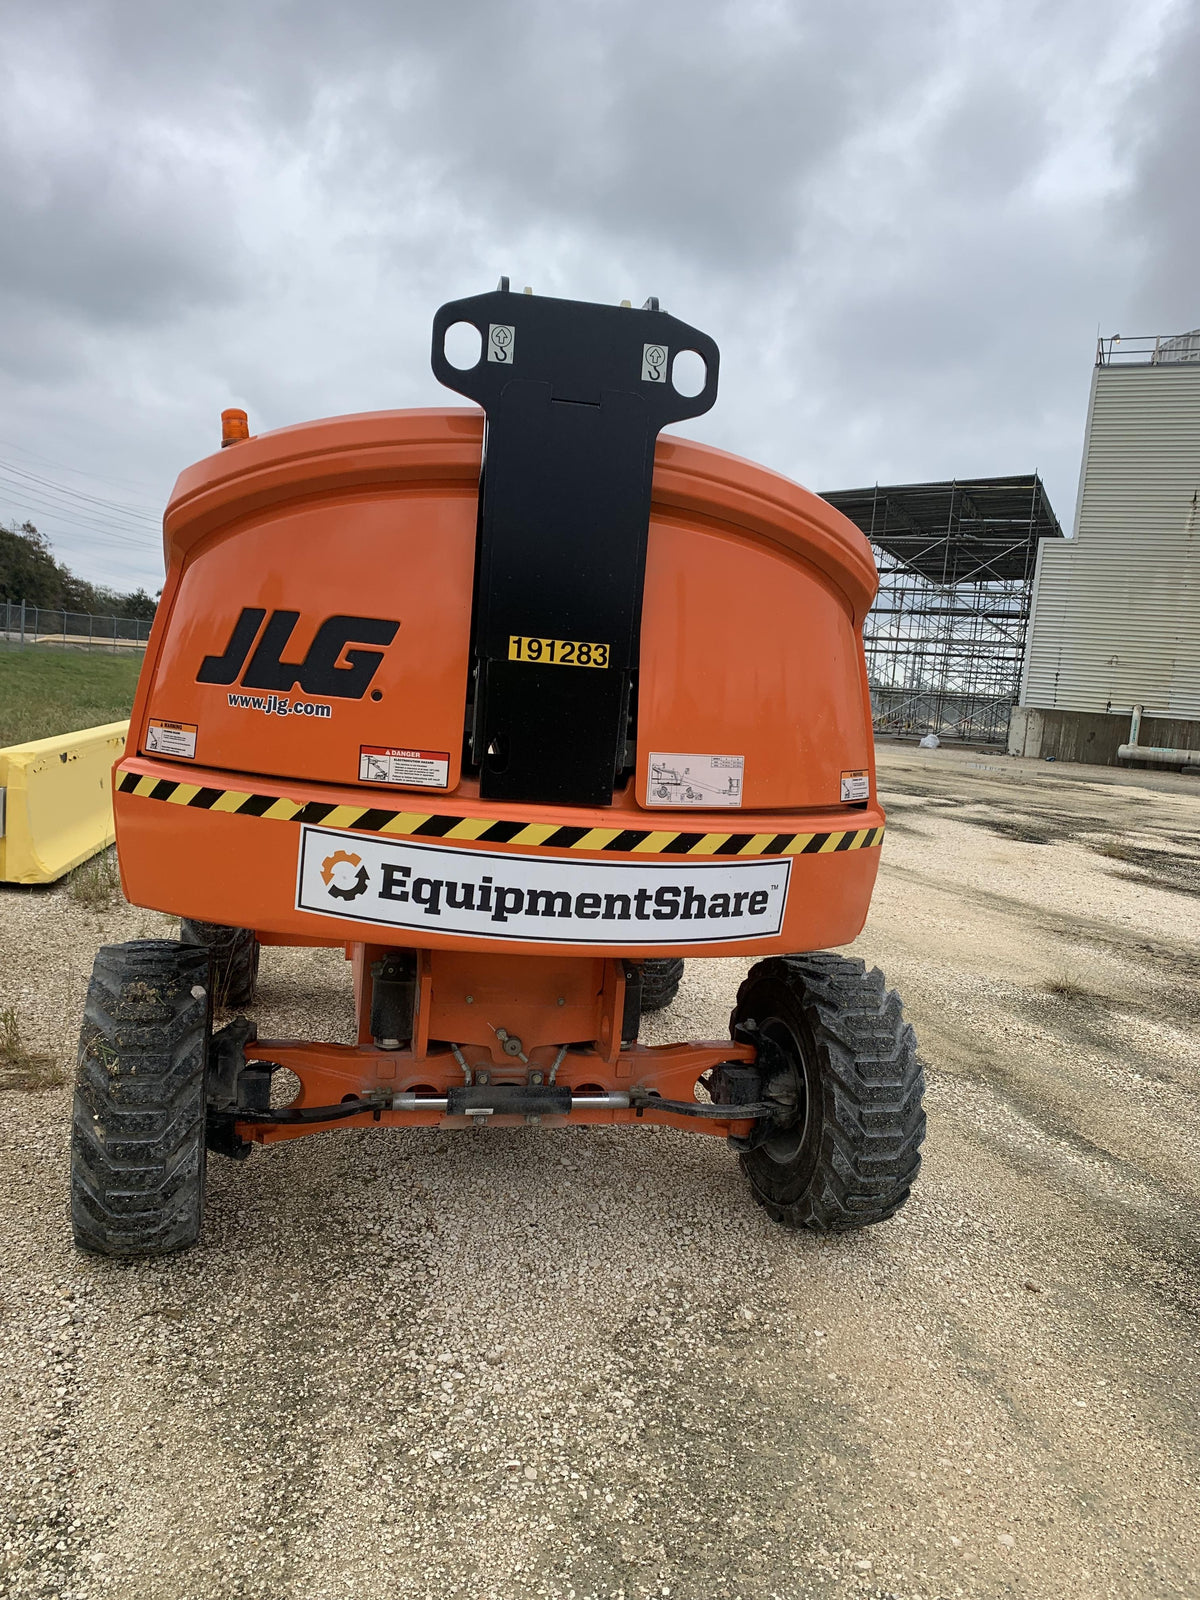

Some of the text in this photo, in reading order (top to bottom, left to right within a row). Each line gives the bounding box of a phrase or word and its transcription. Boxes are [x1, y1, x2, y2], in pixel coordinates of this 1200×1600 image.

[196, 607, 401, 700] JLG
[512, 637, 608, 667] 191283
[227, 693, 332, 718] www.jlg.com
[391, 750, 421, 758] DANGER
[378, 863, 769, 922] EquipmentShare
